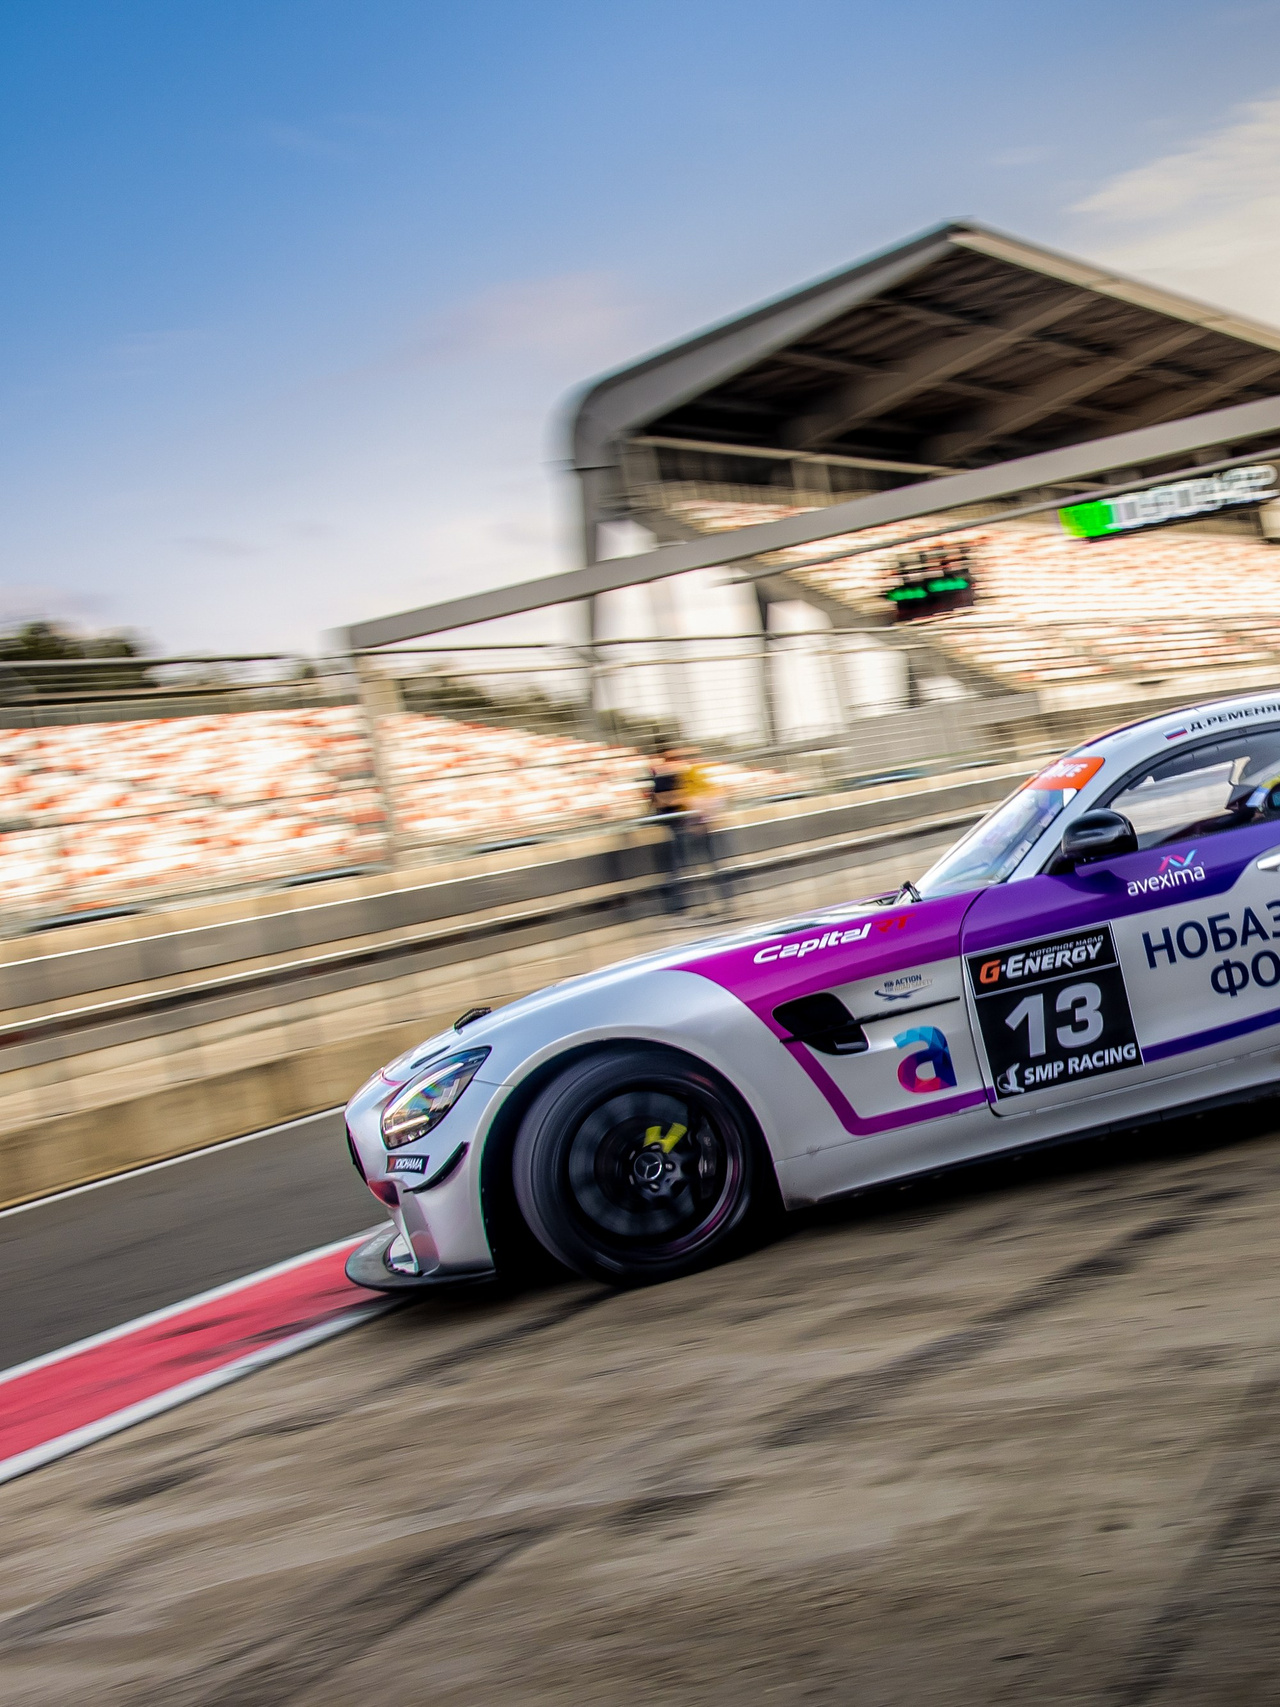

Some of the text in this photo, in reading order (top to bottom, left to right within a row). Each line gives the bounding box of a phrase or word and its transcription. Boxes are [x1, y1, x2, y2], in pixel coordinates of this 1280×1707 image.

[1126, 863, 1206, 897] avexima
[753, 912, 916, 965] Capital RT
[895, 973, 922, 986] ACTION
[1005, 982, 1104, 1058] 13
[1024, 1042, 1136, 1085] SMP RACING
